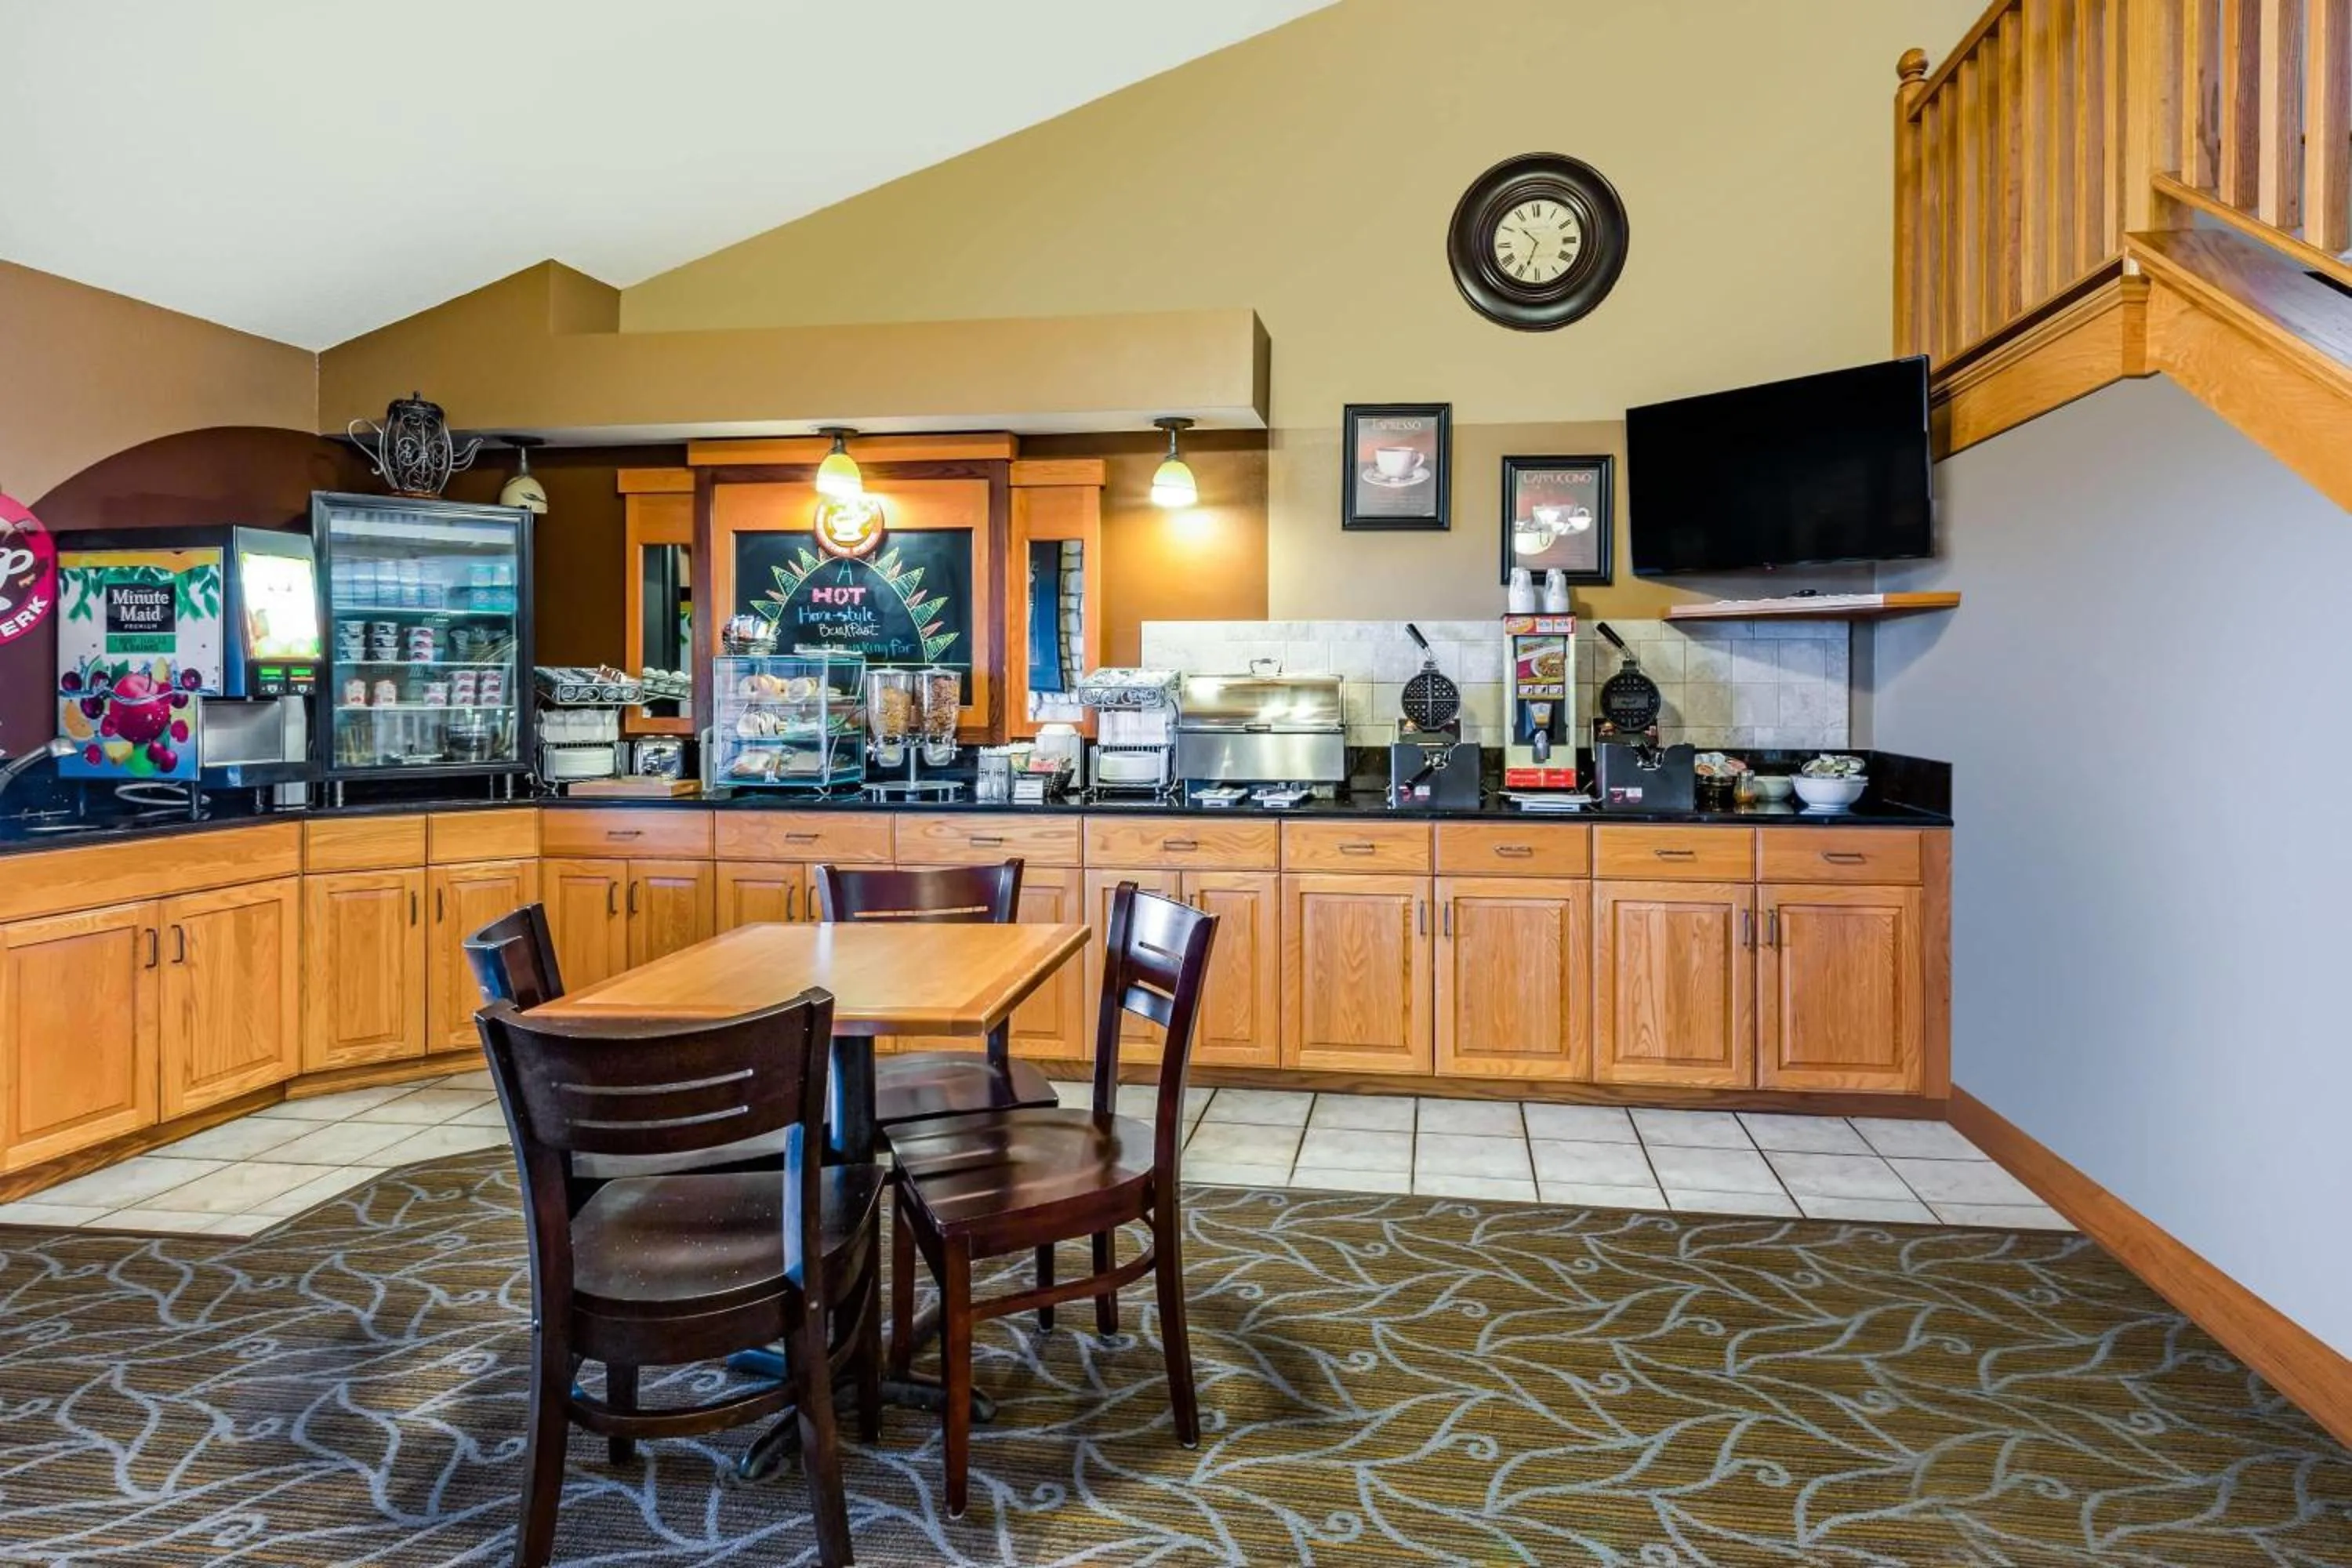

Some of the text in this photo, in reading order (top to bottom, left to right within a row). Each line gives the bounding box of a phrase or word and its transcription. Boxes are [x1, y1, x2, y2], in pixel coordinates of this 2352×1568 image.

[837, 559, 854, 586] A
[112, 589, 170, 604] Minute
[811, 587, 866, 605] HOT
[119, 604, 162, 622] Maid
